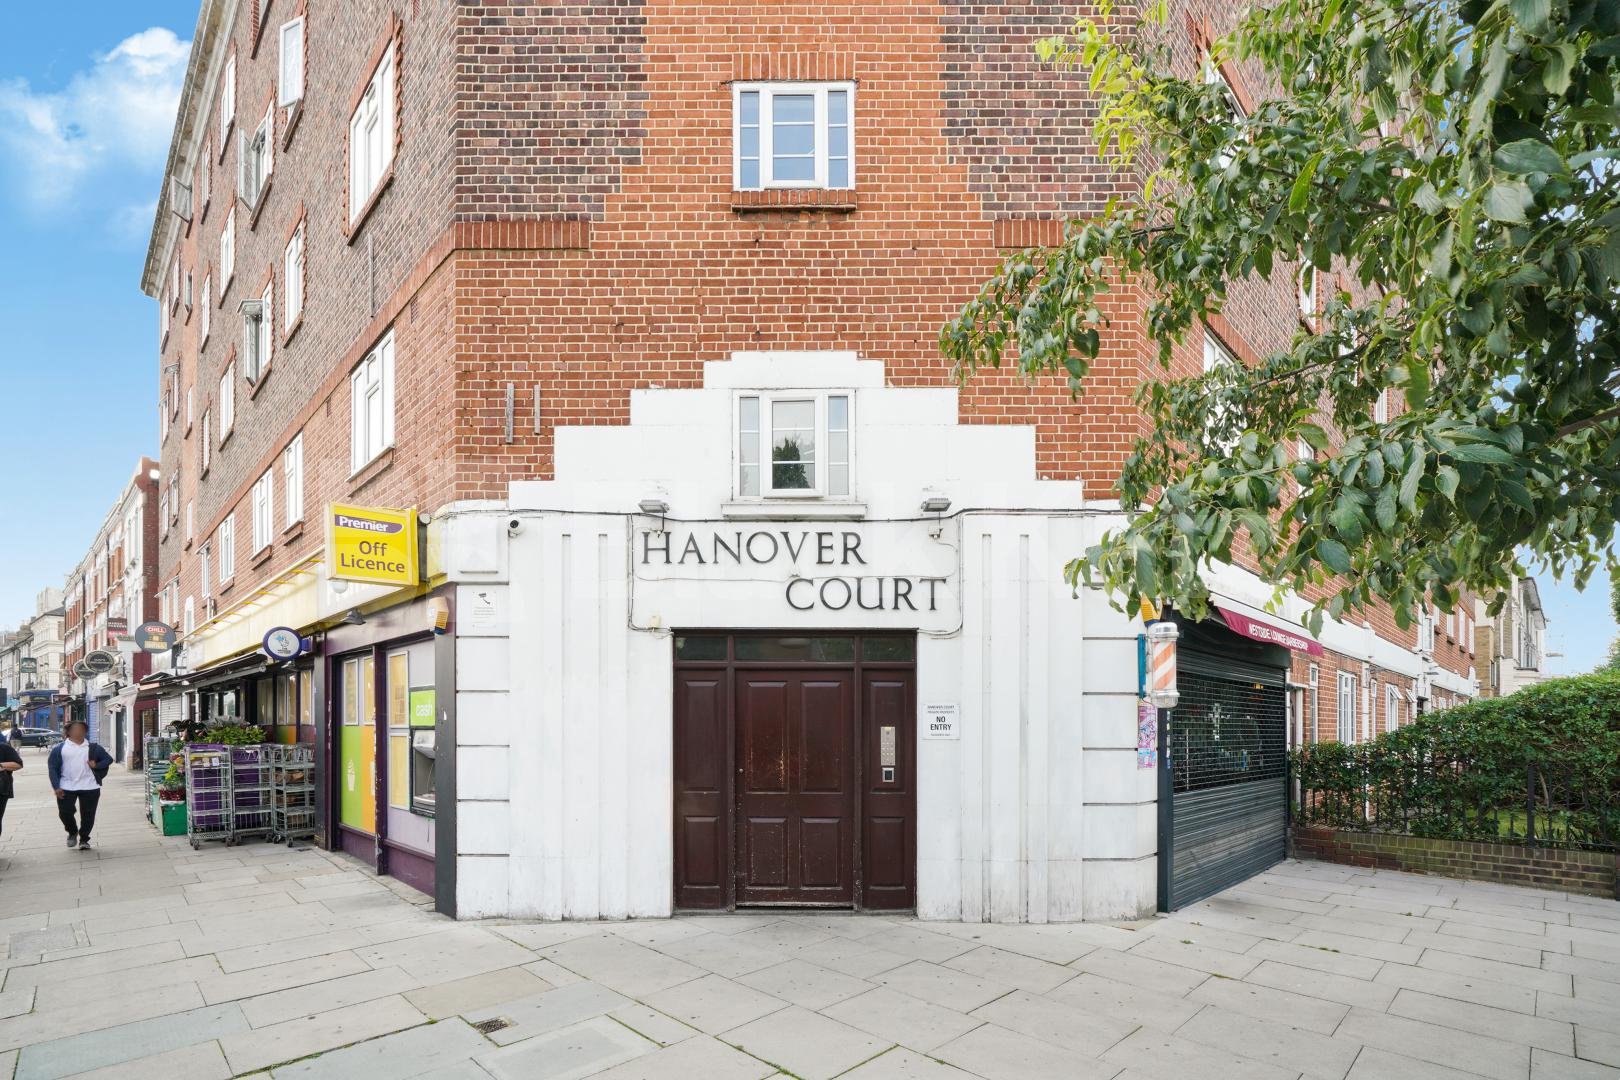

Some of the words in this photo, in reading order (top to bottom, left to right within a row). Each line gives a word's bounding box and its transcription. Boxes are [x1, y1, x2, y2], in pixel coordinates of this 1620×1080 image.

[339, 515, 389, 532] Premier
[358, 540, 388, 557] Off
[640, 531, 868, 566] HANOVER
[340, 552, 406, 574] Licence
[785, 577, 947, 612] COURT
[930, 723, 952, 731] ENTRY
